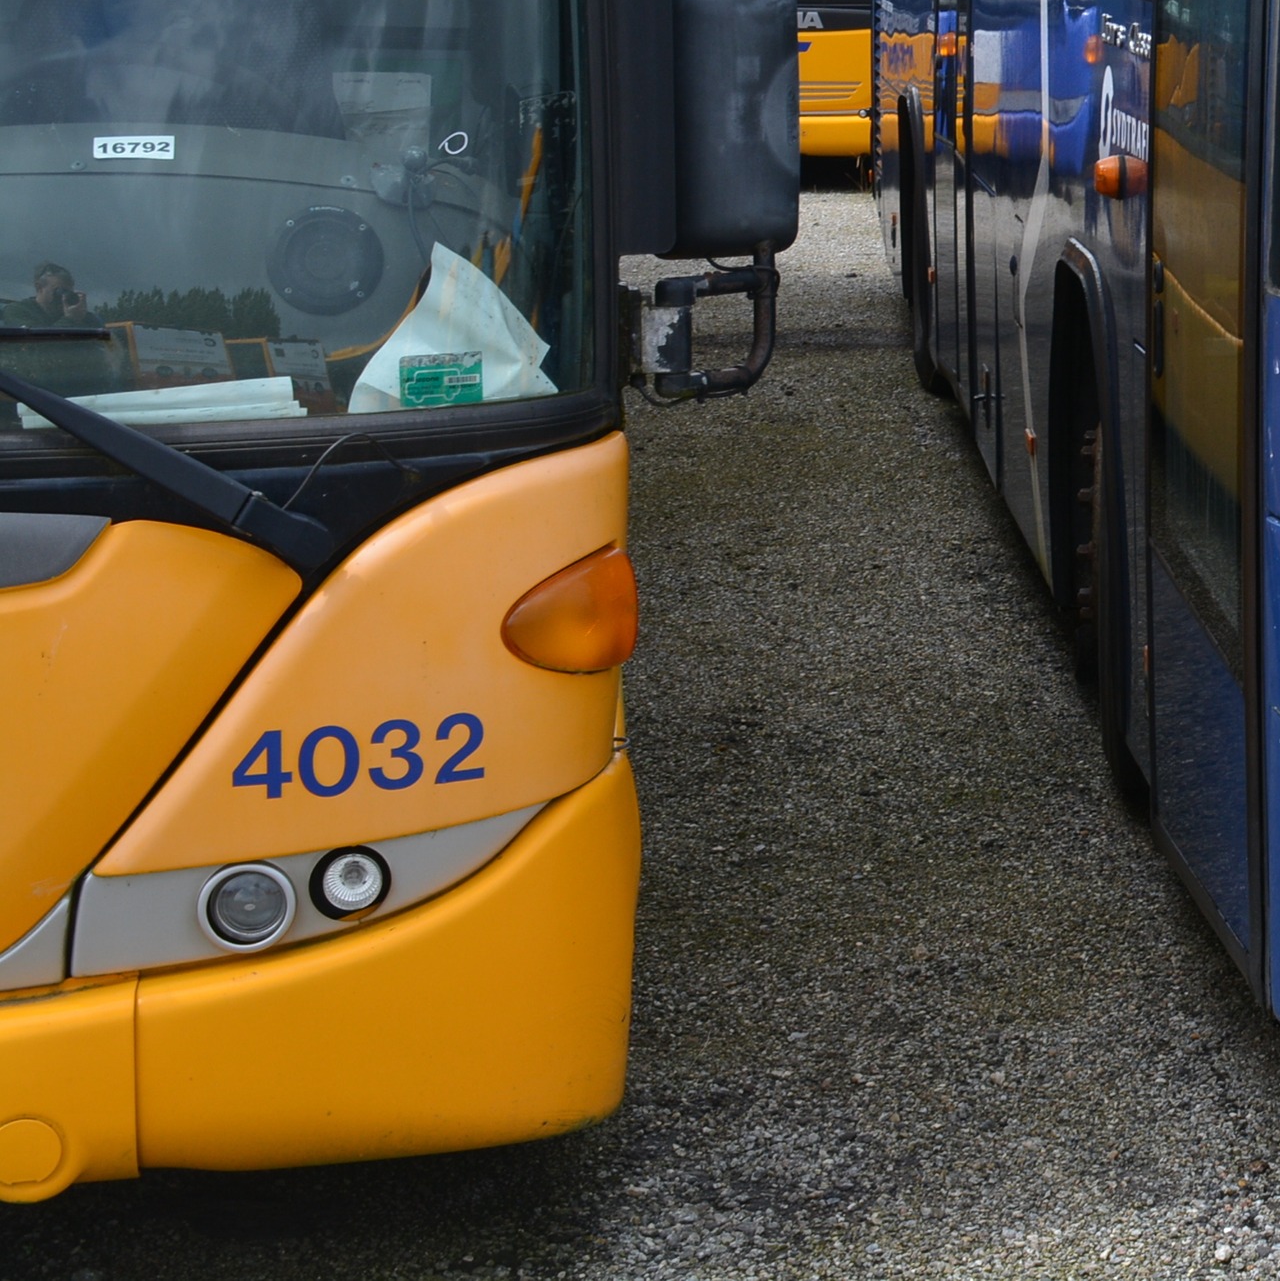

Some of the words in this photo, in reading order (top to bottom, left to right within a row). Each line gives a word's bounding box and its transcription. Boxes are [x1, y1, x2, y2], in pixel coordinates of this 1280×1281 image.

[97, 141, 171, 154] 16792
[1112, 108, 1149, 163] SYDTRAFI
[232, 712, 486, 799] 4032
